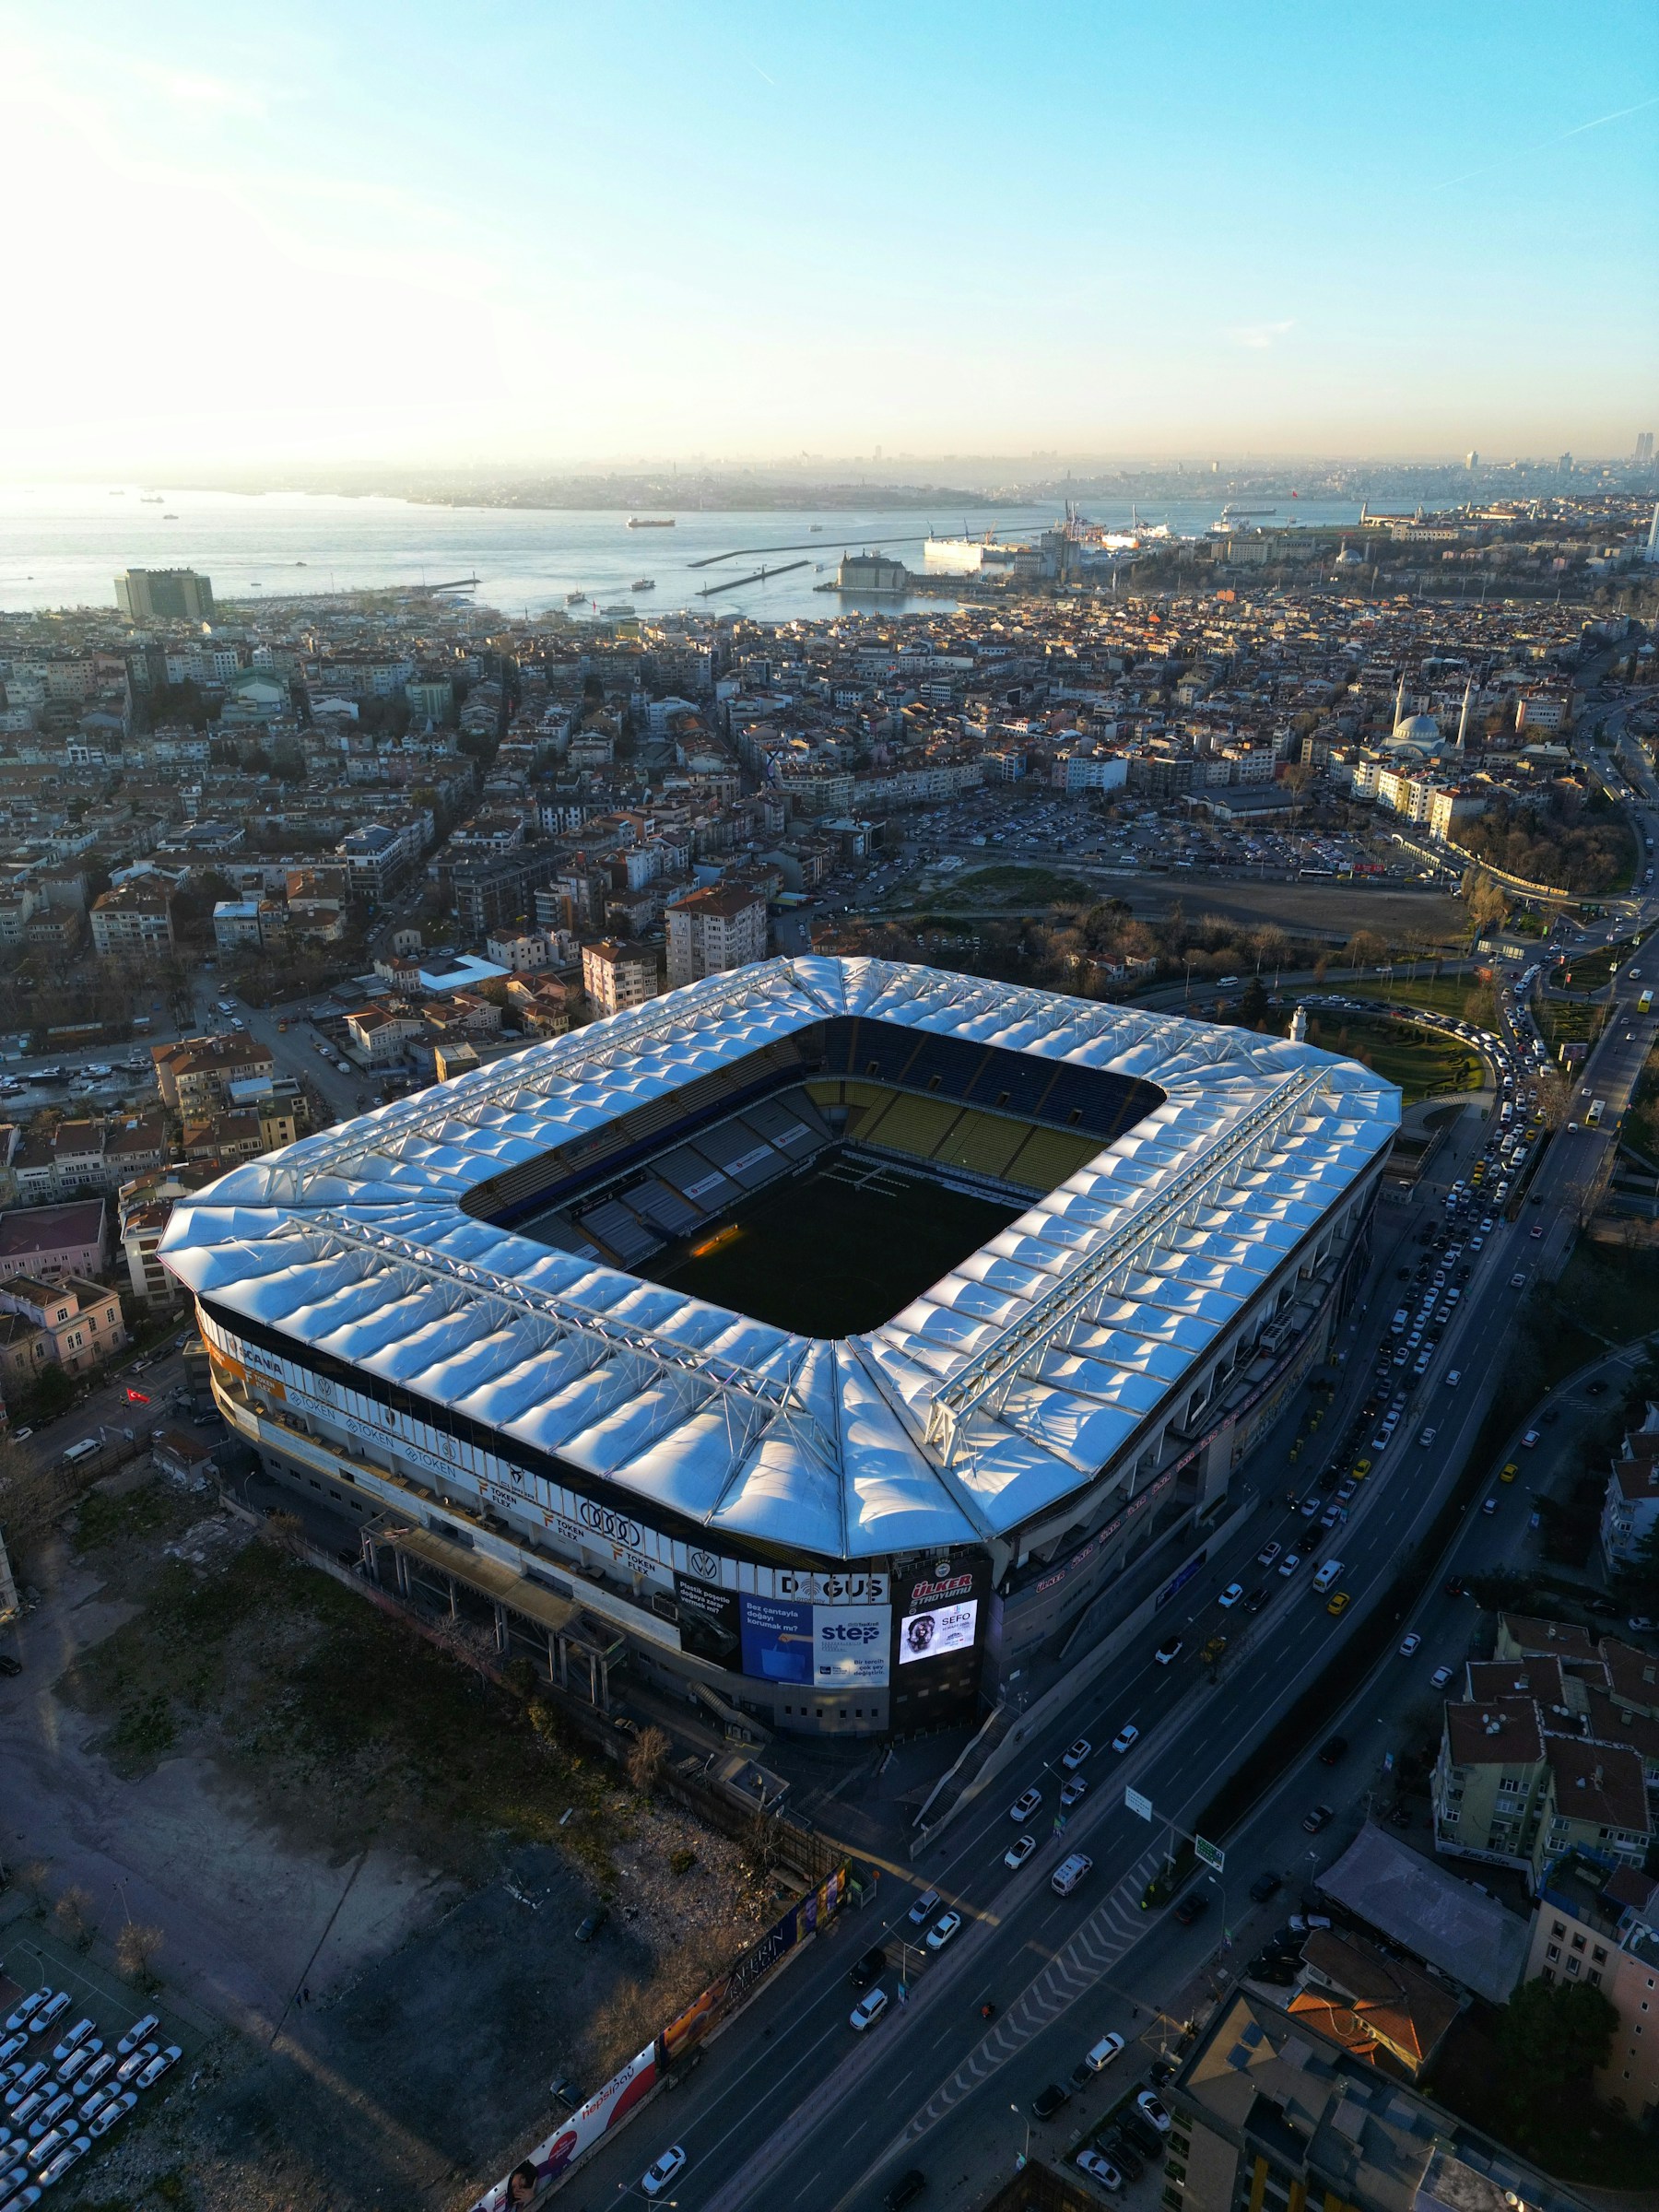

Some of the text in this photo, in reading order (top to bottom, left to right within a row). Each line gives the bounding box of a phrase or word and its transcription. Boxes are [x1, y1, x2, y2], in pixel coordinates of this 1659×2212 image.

[239, 1347, 282, 1375] SCANIA
[254, 1375, 275, 1388] TOKEN
[301, 1397, 335, 1419] TOKEN
[358, 1424, 394, 1448] TOKEN
[418, 1452, 456, 1477] TOKEN
[490, 1487, 517, 1504] TOKEN
[492, 1496, 512, 1509] FLEX
[557, 1519, 584, 1537] TOKEN
[558, 1527, 578, 1542] FLEX
[626, 1552, 655, 1571] TOKEN
[628, 1561, 649, 1576] FLEX
[680, 1581, 702, 1594] Plastik
[912, 1574, 972, 1599] ÜLKER
[681, 1596, 719, 1614] vermek mi?
[706, 1599, 724, 1608] zarar
[911, 1586, 971, 1606] STADYUMU
[747, 1603, 798, 1618] Bez çantayla
[942, 1613, 971, 1626] SEFO
[747, 1618, 782, 1630] korumak
[822, 1625, 879, 1643] step
[582, 2067, 634, 2120] hepsipay
